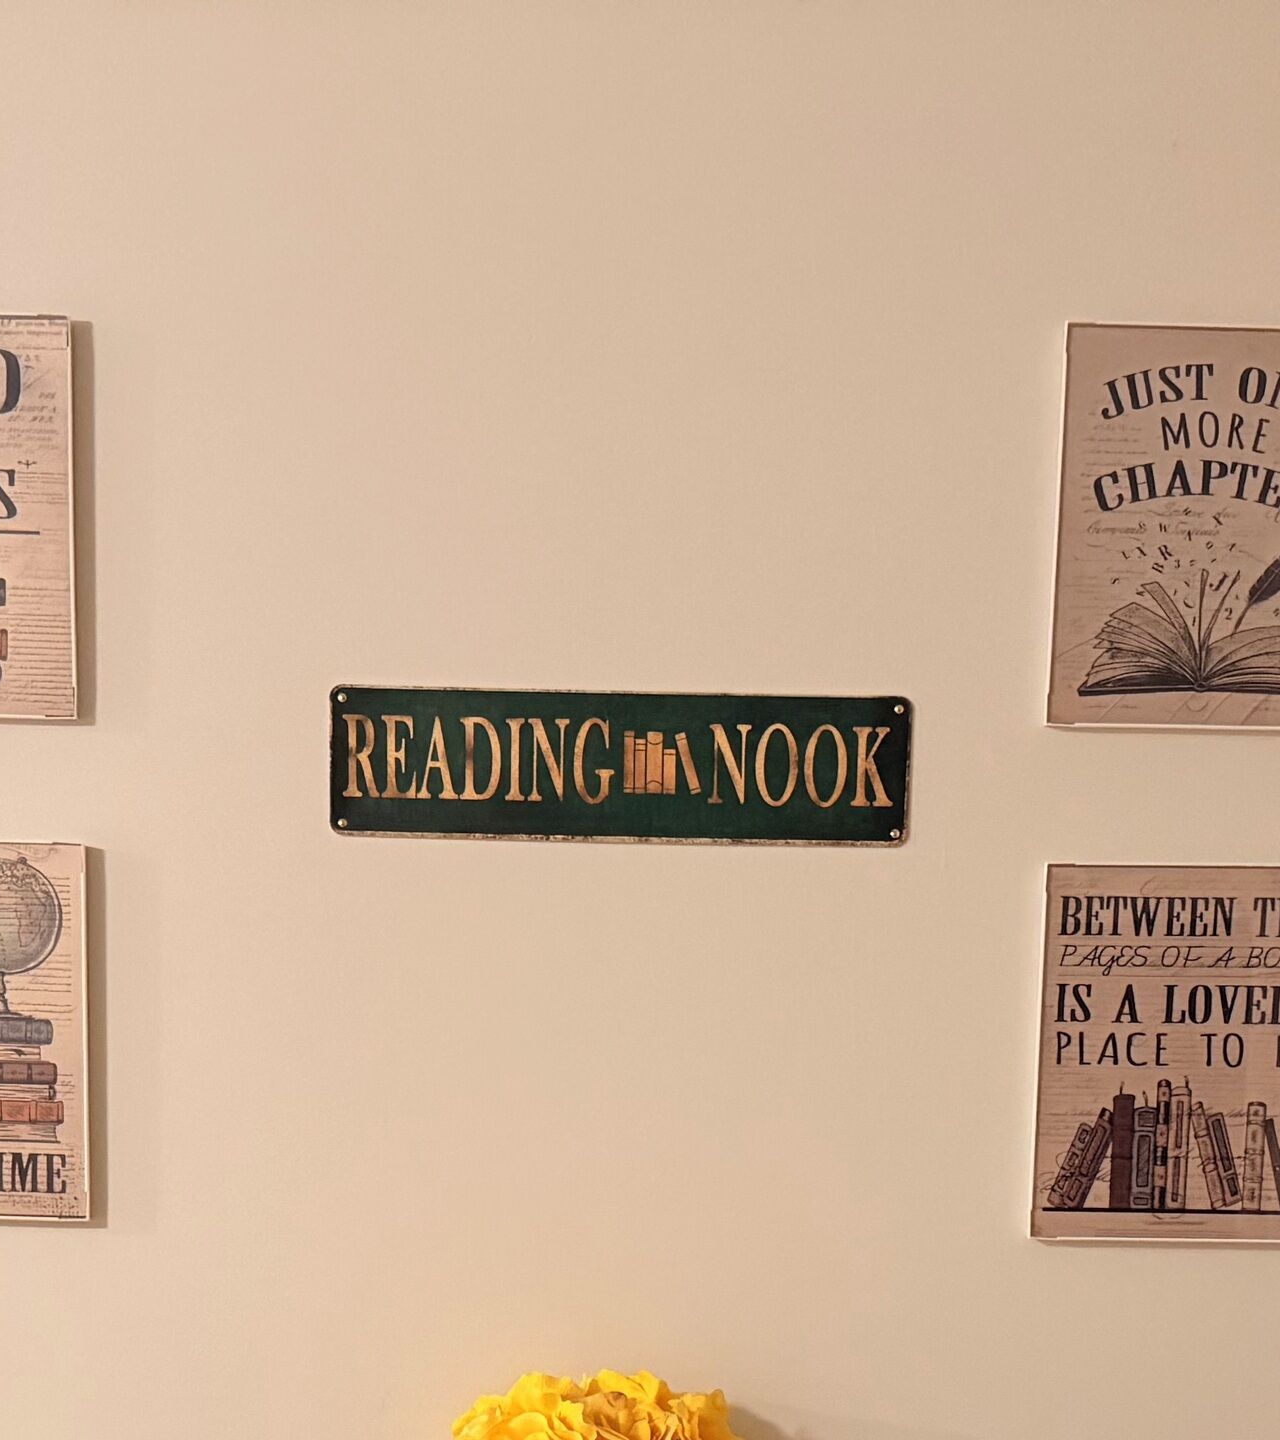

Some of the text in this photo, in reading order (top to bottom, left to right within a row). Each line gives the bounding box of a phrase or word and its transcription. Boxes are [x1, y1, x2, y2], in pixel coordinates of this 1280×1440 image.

[1101, 363, 1214, 420] JUST
[1161, 411, 1271, 454] MORE
[342, 714, 893, 808] READING NOOK
[1058, 895, 1238, 938] BETWEEN
[1161, 945, 1206, 967] OF
[1211, 946, 1235, 968] A
[1055, 983, 1092, 1023] IS
[1112, 984, 1142, 1024] A
[1056, 1031, 1169, 1066] PLACE
[1200, 1033, 1245, 1068] TO
